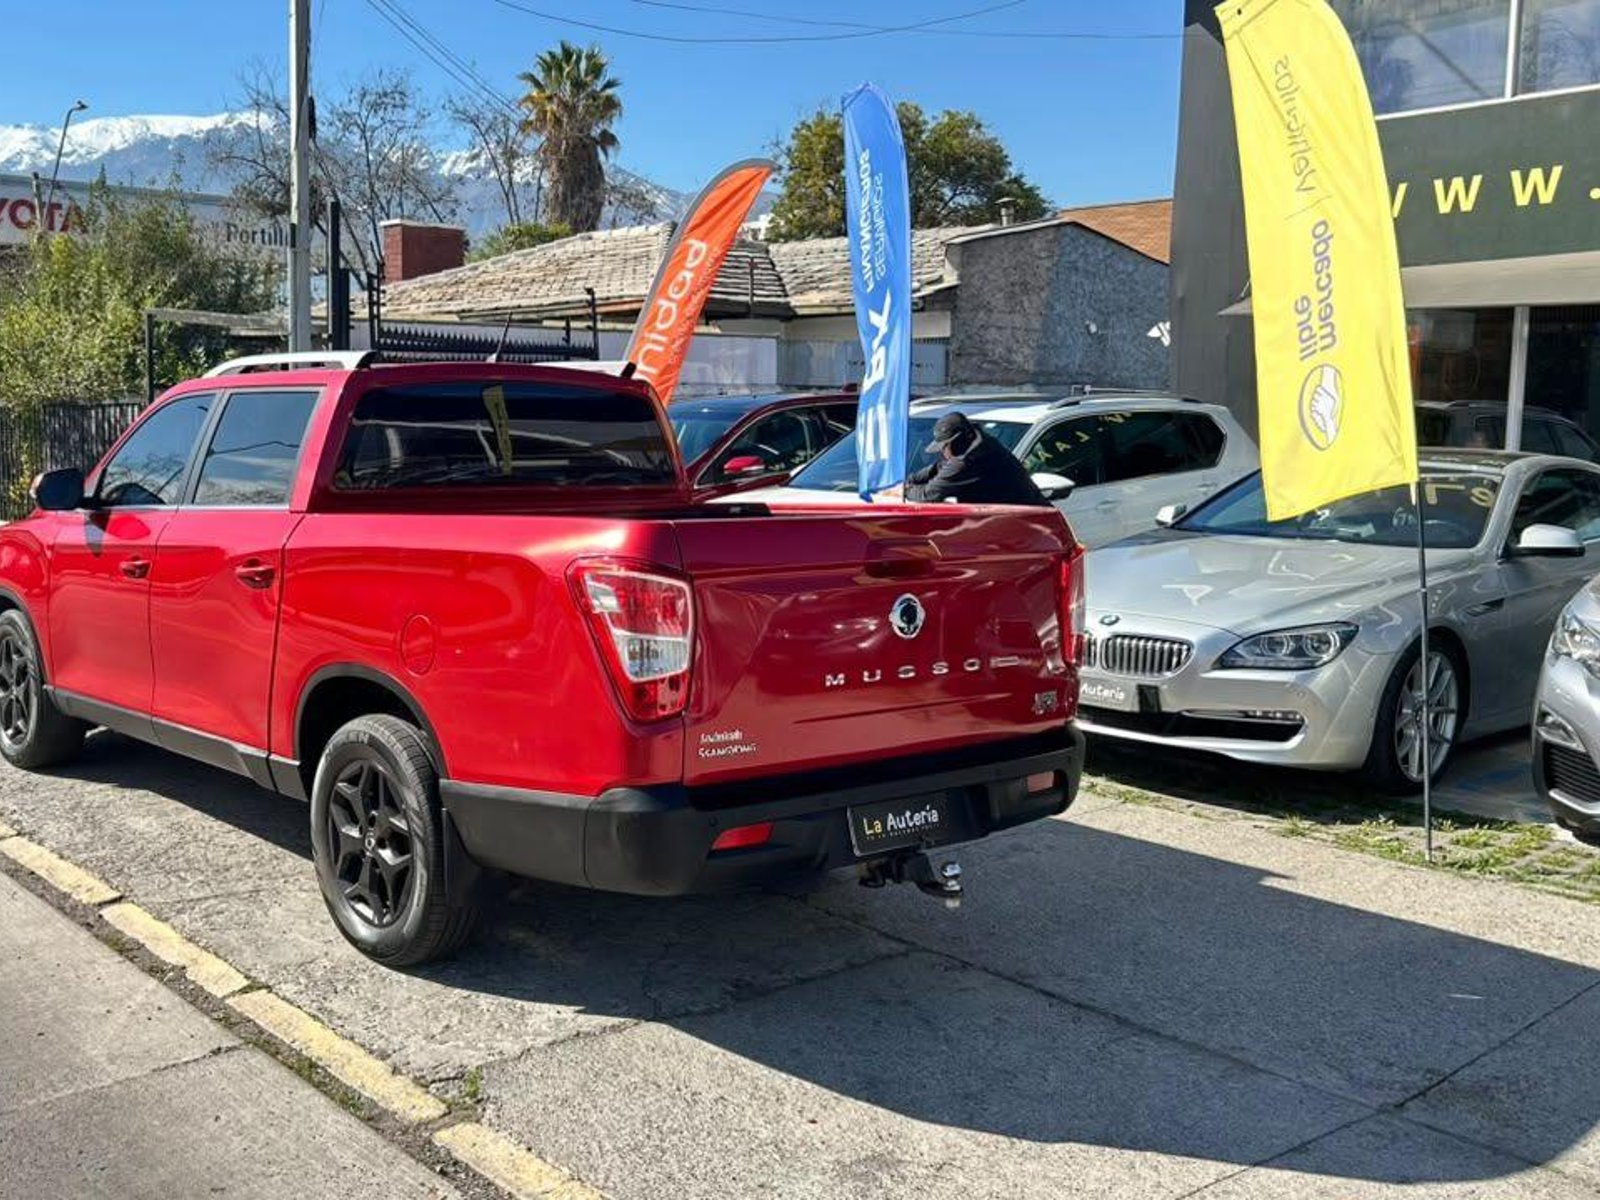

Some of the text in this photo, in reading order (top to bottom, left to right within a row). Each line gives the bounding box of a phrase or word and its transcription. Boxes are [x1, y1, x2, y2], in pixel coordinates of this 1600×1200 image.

[226, 222, 289, 246] Portill
[825, 658, 981, 687] MUSSO
[863, 817, 882, 835] La
